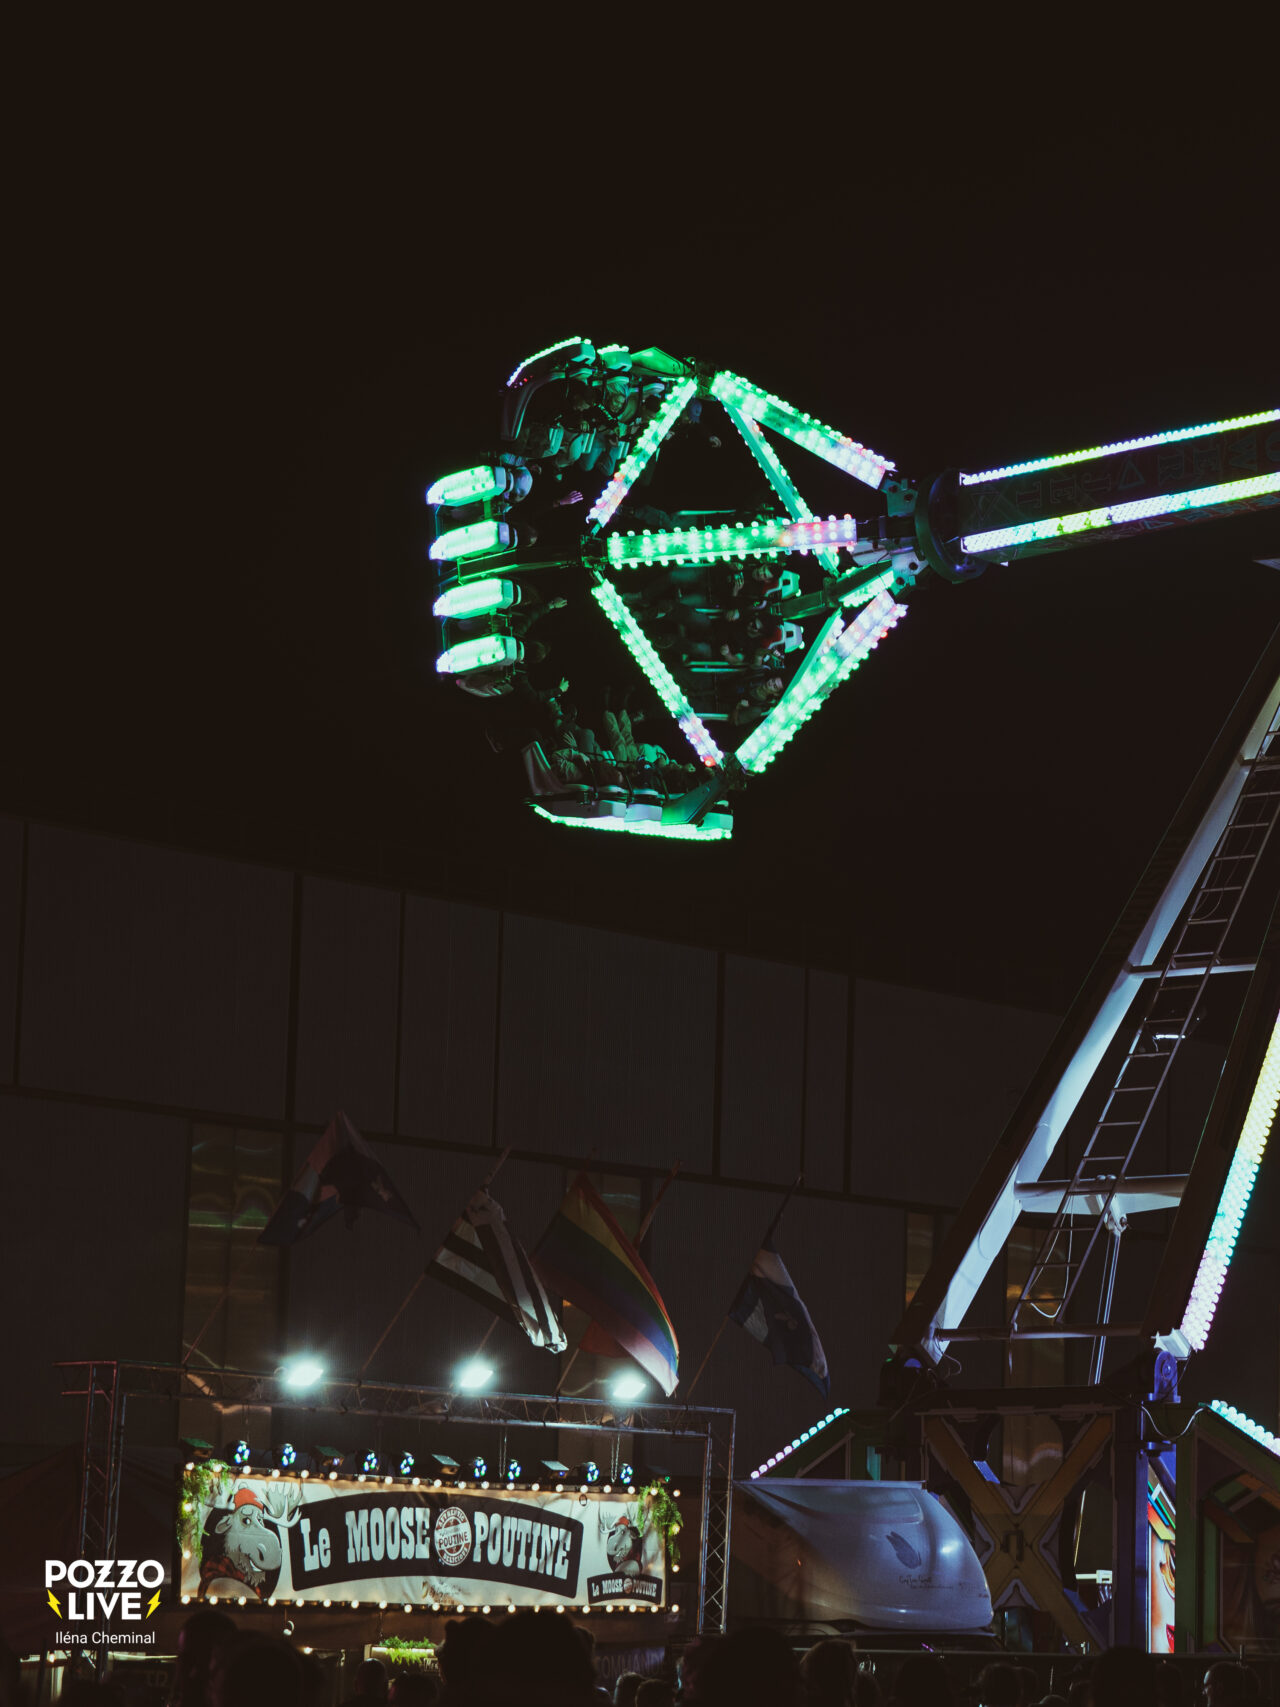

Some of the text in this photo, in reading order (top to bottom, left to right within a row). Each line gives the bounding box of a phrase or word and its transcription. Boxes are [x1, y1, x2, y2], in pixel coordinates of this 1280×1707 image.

[301, 1507, 571, 1580] Le MOOSE POUTINE
[438, 1531, 469, 1549] POUTINE
